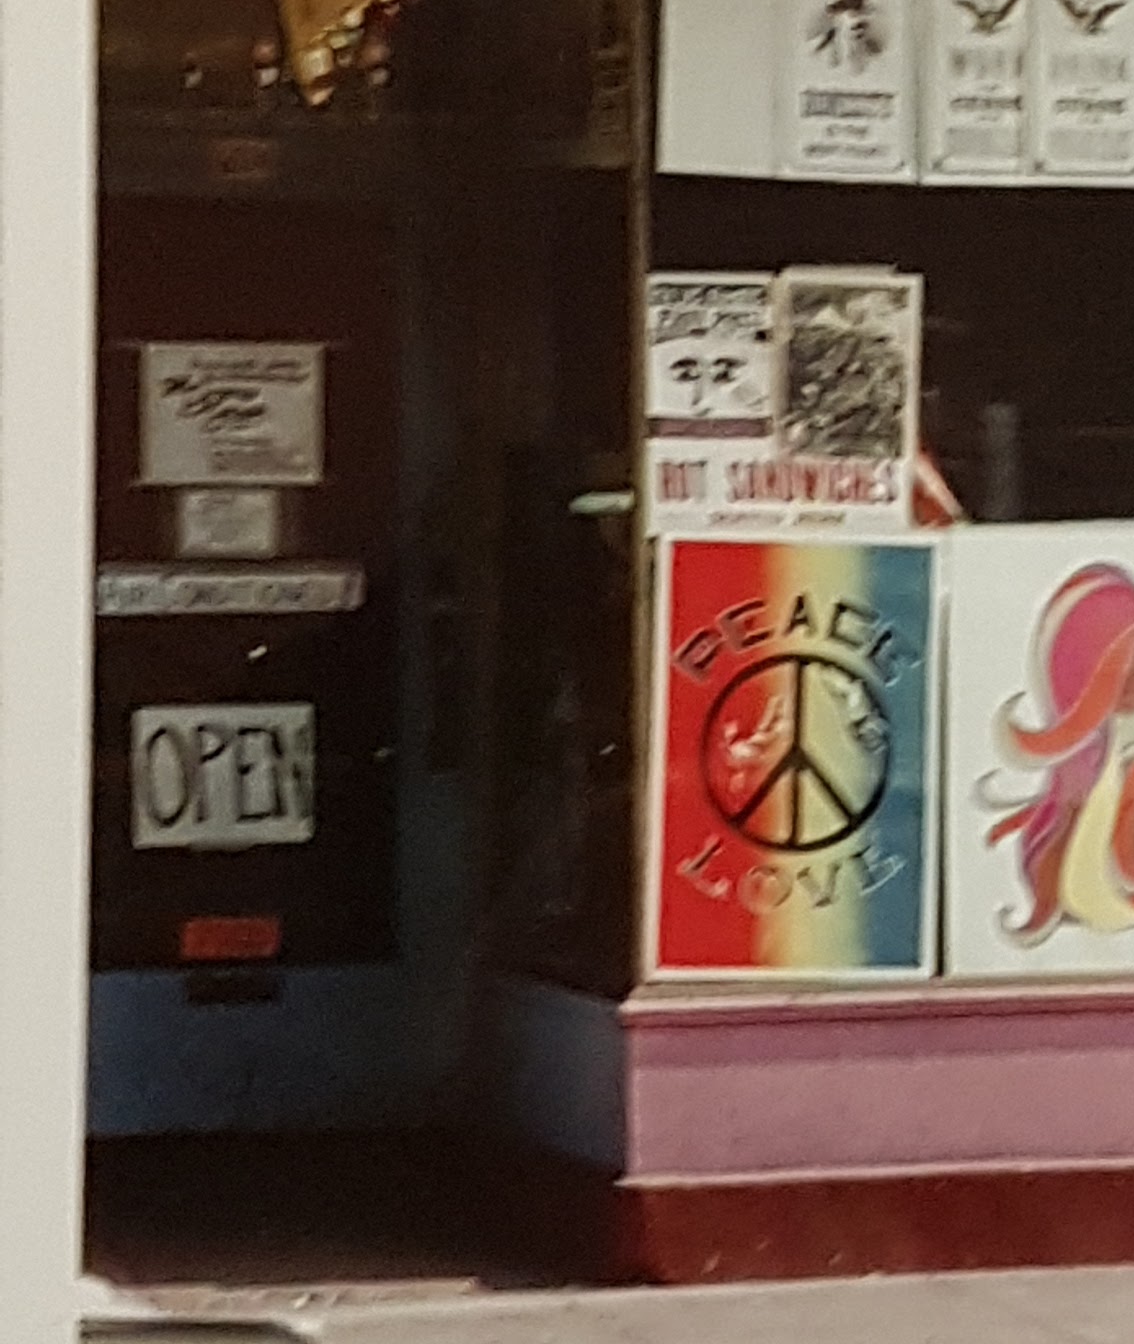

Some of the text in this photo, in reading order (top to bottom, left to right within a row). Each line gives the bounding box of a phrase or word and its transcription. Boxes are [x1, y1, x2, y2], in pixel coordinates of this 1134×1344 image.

[672, 593, 922, 686] PEACE
[148, 726, 308, 828] OPEN
[675, 836, 906, 914] LOVE
